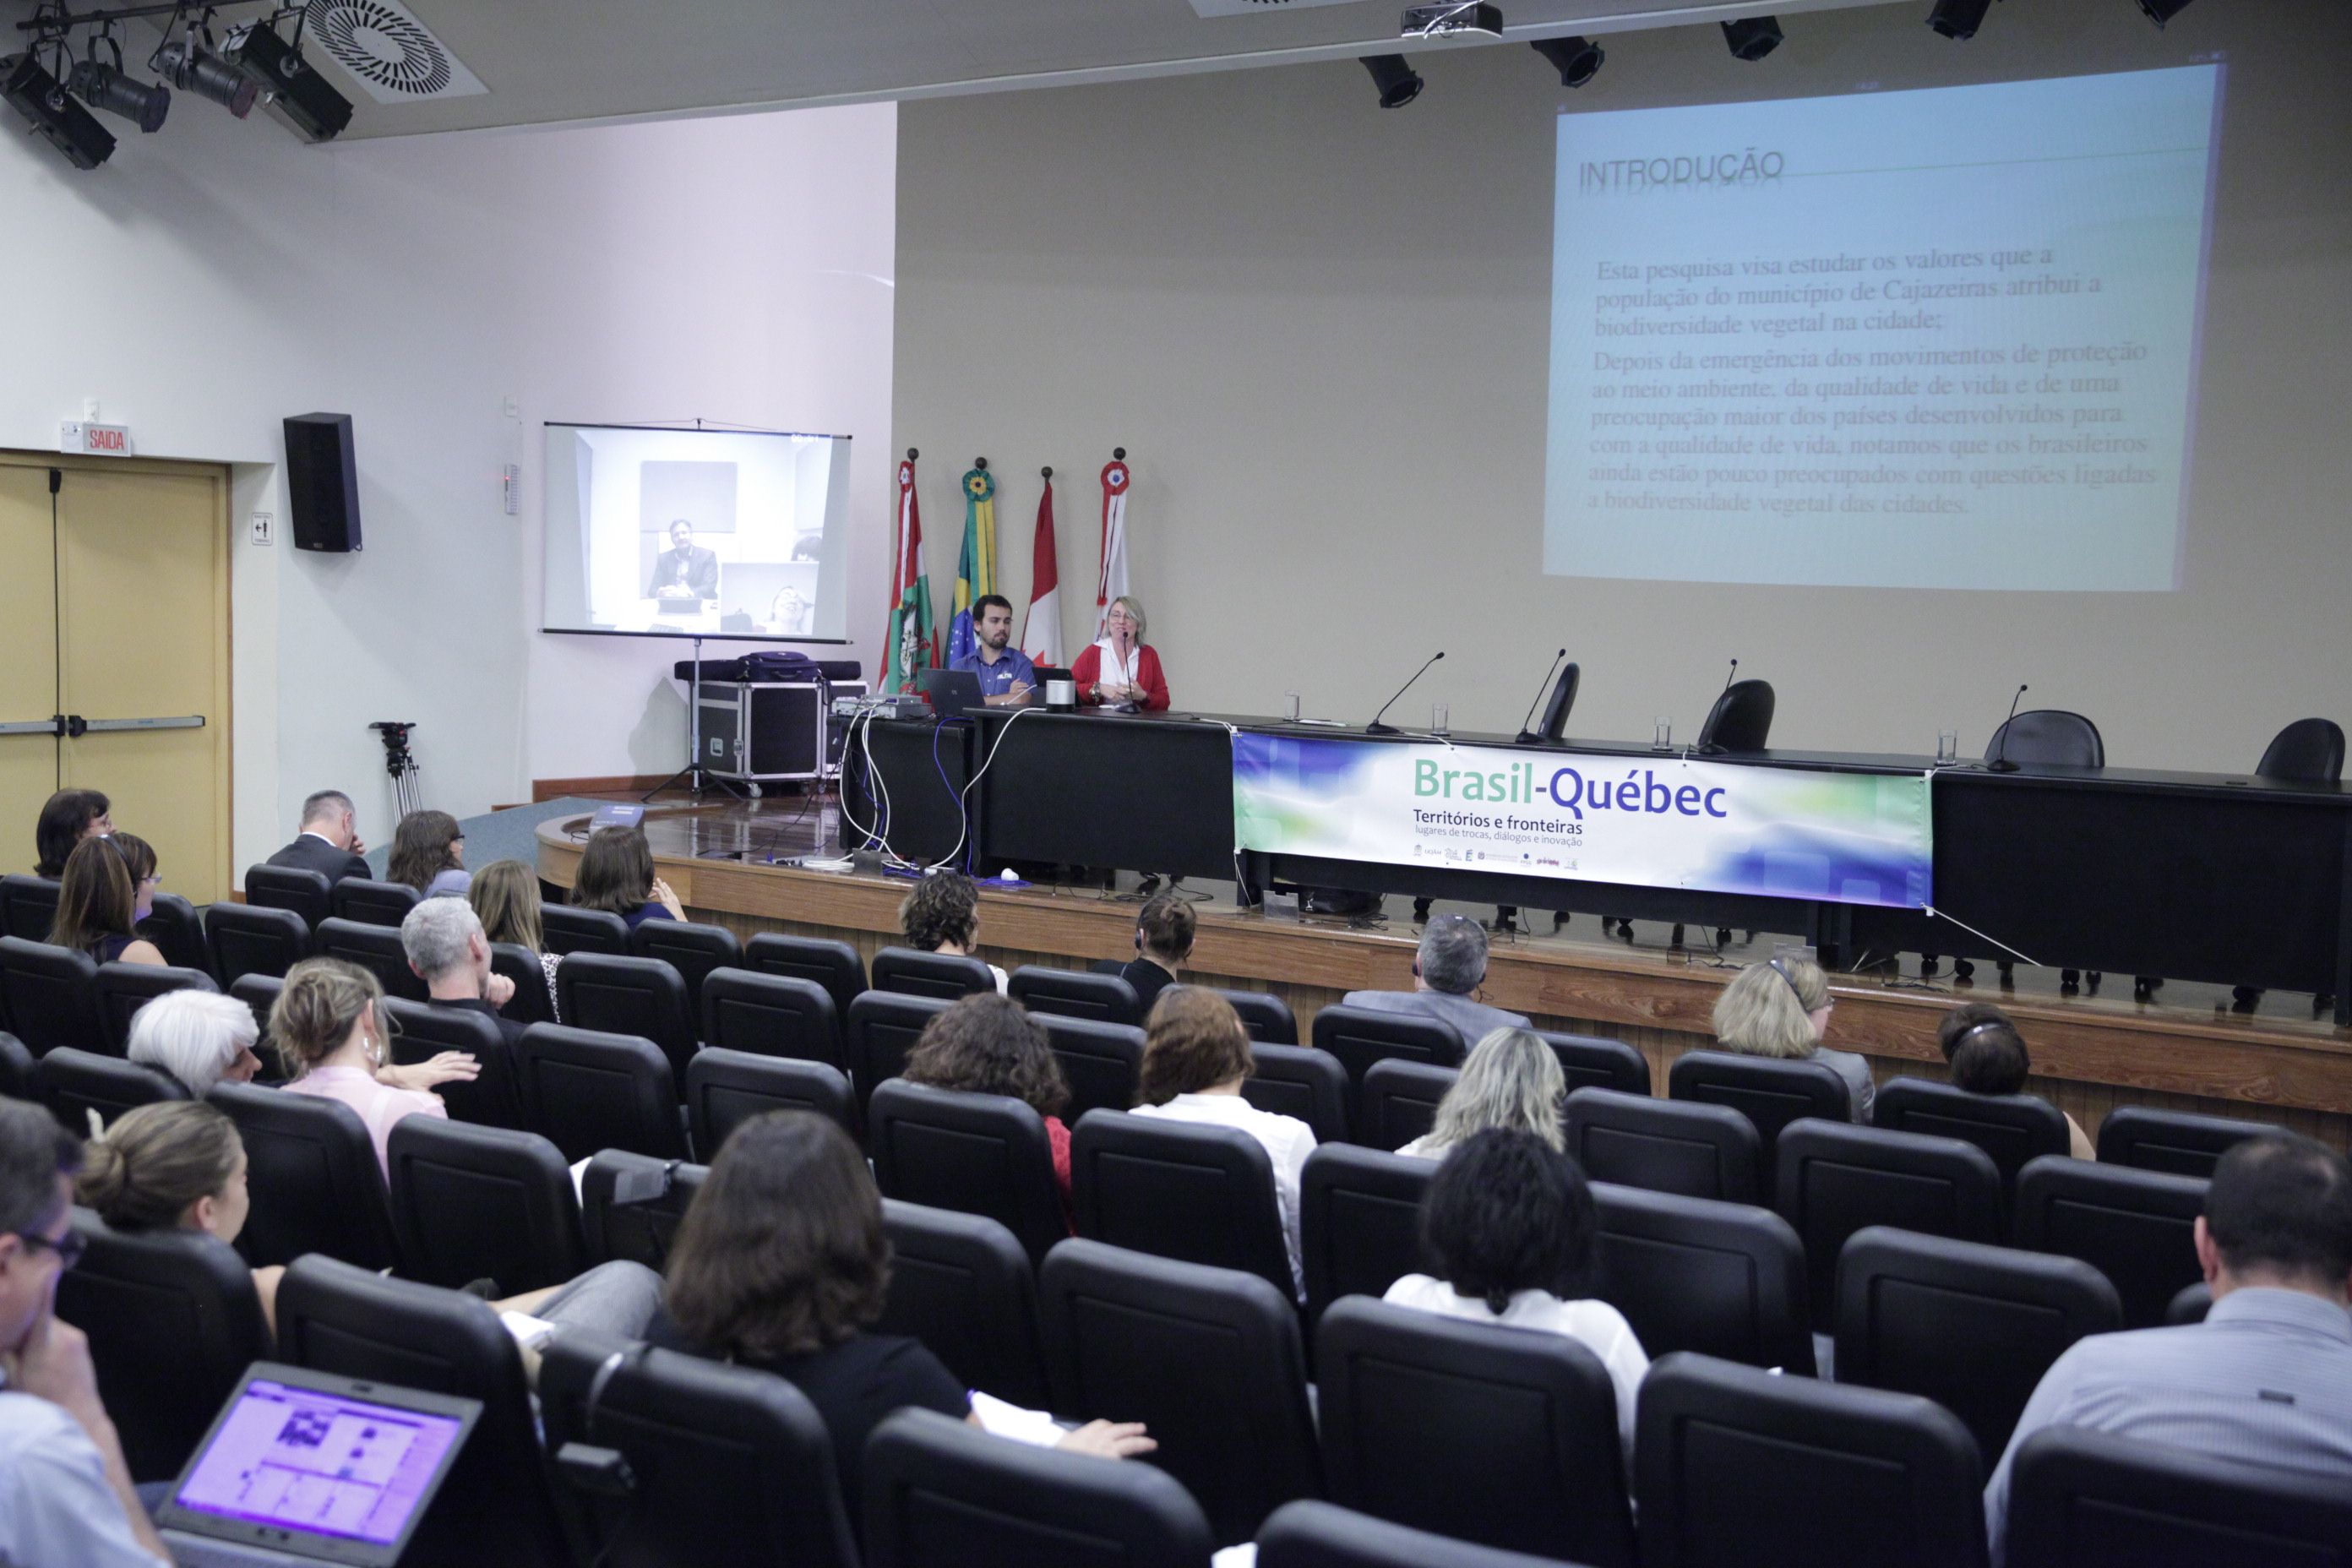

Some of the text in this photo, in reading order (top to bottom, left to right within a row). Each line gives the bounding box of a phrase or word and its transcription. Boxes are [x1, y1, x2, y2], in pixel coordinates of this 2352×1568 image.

[1580, 147, 1784, 187] INTRODUÇÃO
[1597, 249, 2054, 284] Esta pesquisa visa estudar os valores que a
[1596, 273, 2101, 313] população do município de Cajazeiras atribui a
[1594, 309, 1942, 338] biodiversidade vegetal na cidade;
[1594, 341, 2147, 375] Depois da emergência dos movimentos de proteção
[1592, 384, 1615, 398] ao
[1622, 380, 1671, 398] meio
[1784, 378, 1809, 397] da
[1815, 376, 1919, 401] qualidade
[1928, 375, 1952, 395] de
[1962, 374, 2008, 395] vida
[2016, 379, 2028, 394] e
[2035, 373, 2061, 394] de
[2071, 377, 2120, 393] uma
[1591, 404, 2122, 430] preocupação maior dos países desenvolvidos para
[1589, 439, 1631, 454] com
[1638, 439, 1648, 454] a
[1655, 435, 1753, 459] qualidade
[1760, 435, 1784, 454] de
[1850, 439, 1941, 454] notamos
[1949, 439, 1989, 459] que
[1995, 439, 2021, 454] os
[2028, 433, 2148, 454] brasileiros
[1588, 463, 2156, 489] ainda estão pouco preocupados com questões ligadas
[1587, 495, 1598, 508] a
[1604, 491, 1751, 511] biodiversidade
[1758, 493, 1832, 518] vegetal
[1840, 494, 1875, 512] das
[1414, 759, 1727, 819] Brasil-Québec
[1413, 808, 1582, 835] Territórios e fronteiras
[1415, 825, 1446, 836] lugares
[1449, 827, 1460, 836] de
[1462, 829, 1491, 841] trocas,
[1494, 831, 1531, 844] diálogos
[1541, 836, 1582, 847] inovação
